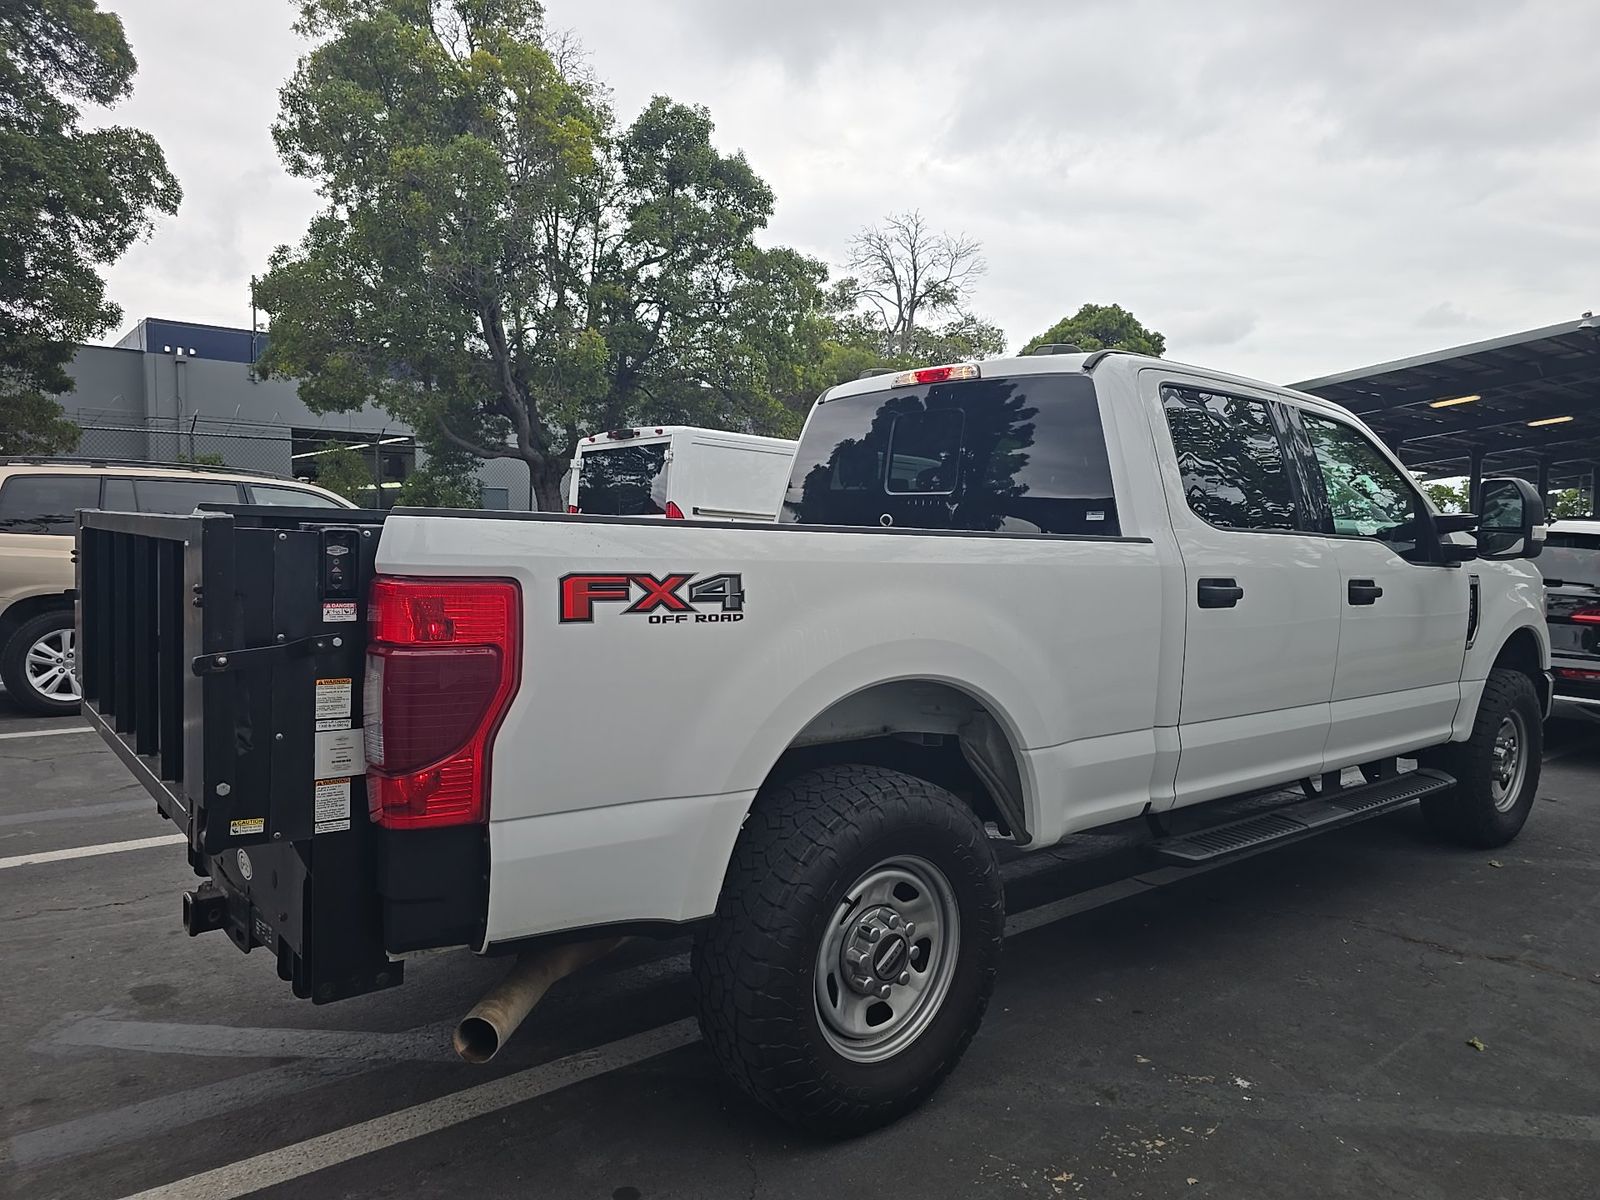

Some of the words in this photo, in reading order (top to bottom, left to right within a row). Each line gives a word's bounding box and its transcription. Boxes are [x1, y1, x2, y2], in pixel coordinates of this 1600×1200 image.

[559, 573, 745, 624] FX4
[648, 615, 688, 624] OFF
[695, 614, 744, 623] ROAD
